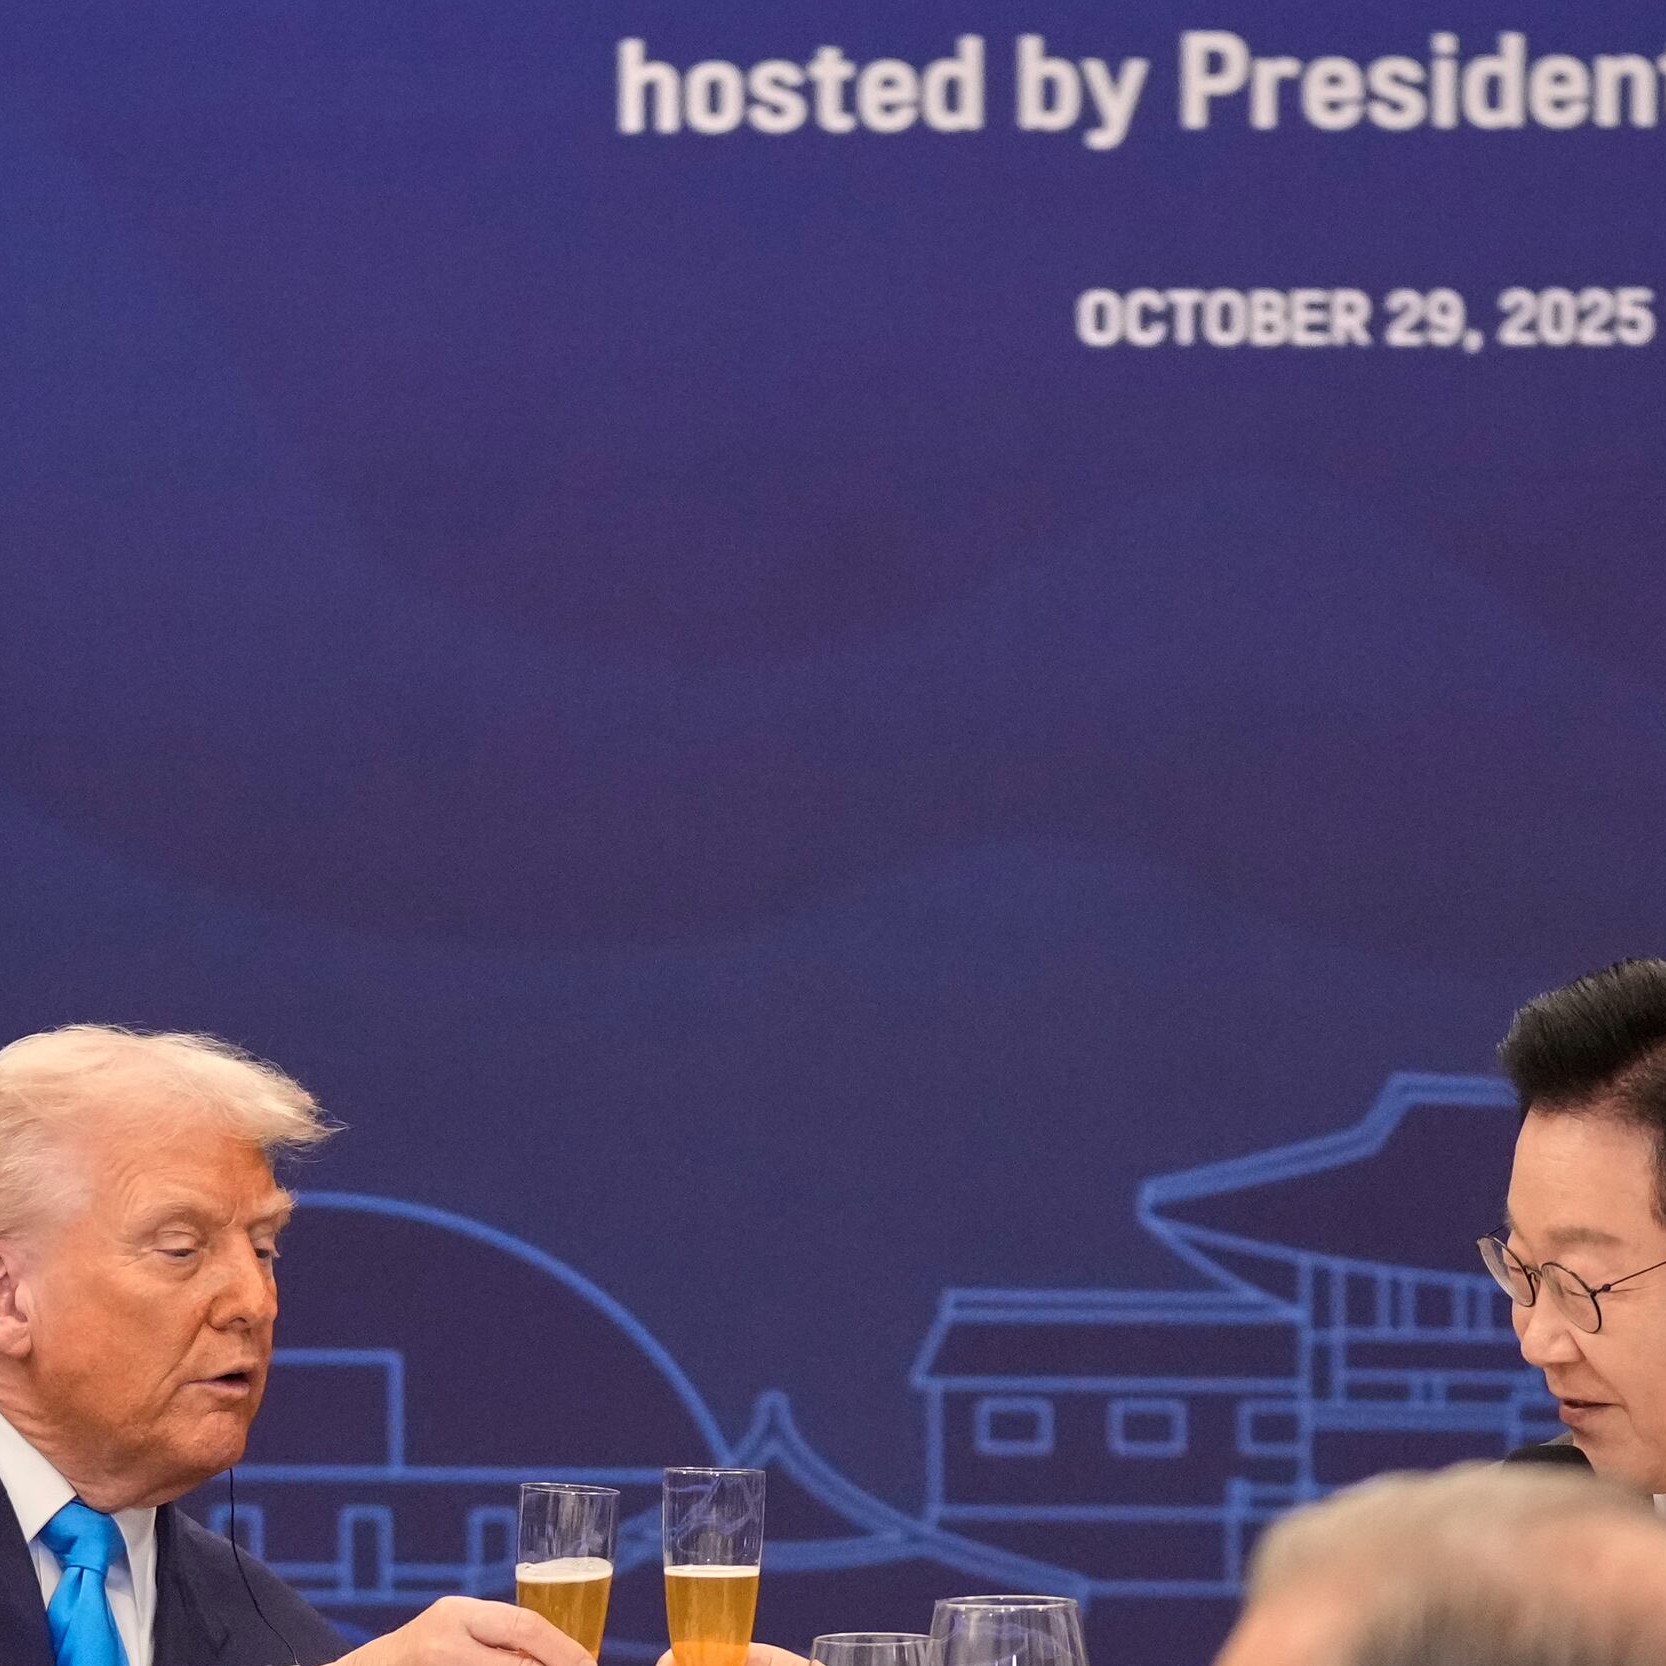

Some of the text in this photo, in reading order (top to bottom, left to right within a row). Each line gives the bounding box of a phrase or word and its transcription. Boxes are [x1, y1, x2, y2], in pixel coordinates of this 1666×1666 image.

[617, 35, 985, 134] hosted
[1017, 34, 1149, 150] by
[1076, 288, 1371, 347] OCTOBER
[1385, 289, 1483, 353] 29,
[1498, 287, 1655, 346] 2025
